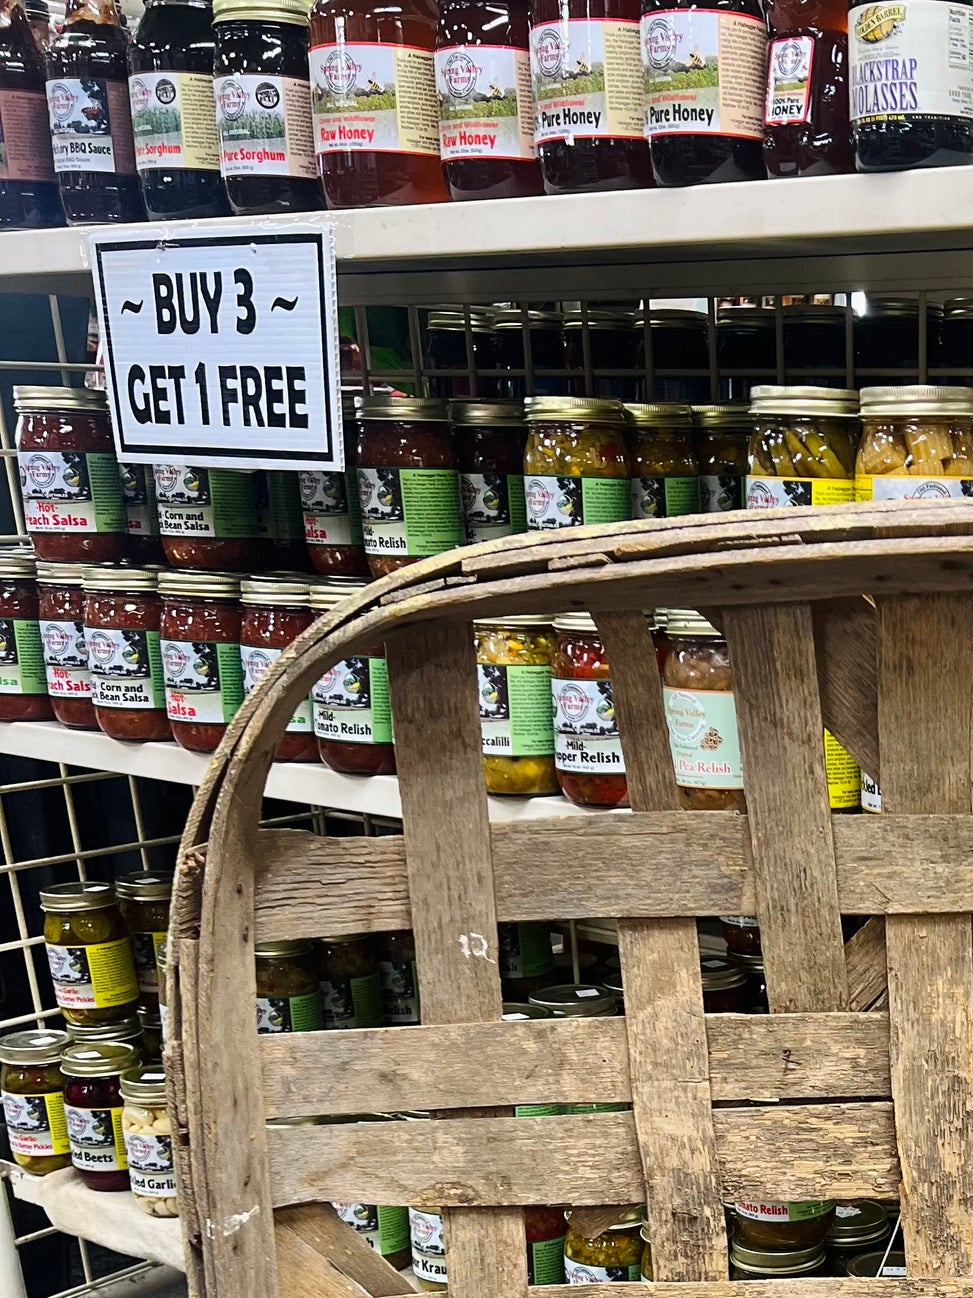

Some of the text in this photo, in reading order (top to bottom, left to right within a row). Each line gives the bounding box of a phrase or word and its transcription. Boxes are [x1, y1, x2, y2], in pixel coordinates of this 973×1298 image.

[876, 6, 901, 22] BARREL
[460, 64, 483, 75] Valley
[541, 108, 602, 129] Pure Honey
[650, 104, 714, 126] Pure Honey
[321, 125, 374, 143] Raw Honey
[442, 130, 496, 149] Raw Honey
[69, 142, 111, 155] BBQ Sauce
[145, 142, 182, 157] Sorghum
[240, 147, 286, 163] Sorghum
[152, 271, 223, 335] BUY
[233, 267, 256, 335] 3
[127, 361, 309, 429] GET 1 FREE
[52, 514, 87, 526] Salsa
[164, 510, 204, 521] Corn and
[164, 520, 210, 531] Bean Salsa
[305, 527, 327, 538] alsa
[378, 537, 407, 549] Relish
[66, 680, 91, 692] Sals
[100, 682, 143, 692] Corn and
[100, 692, 149, 702] Bean Salsa
[685, 709, 706, 719] Valley
[340, 723, 372, 736] Relish
[580, 752, 620, 763] Relish
[679, 760, 731, 774] Pea Relish
[84, 1151, 114, 1163] Beets
[760, 1204, 788, 1215] Relish
[421, 1259, 447, 1275] Krau
